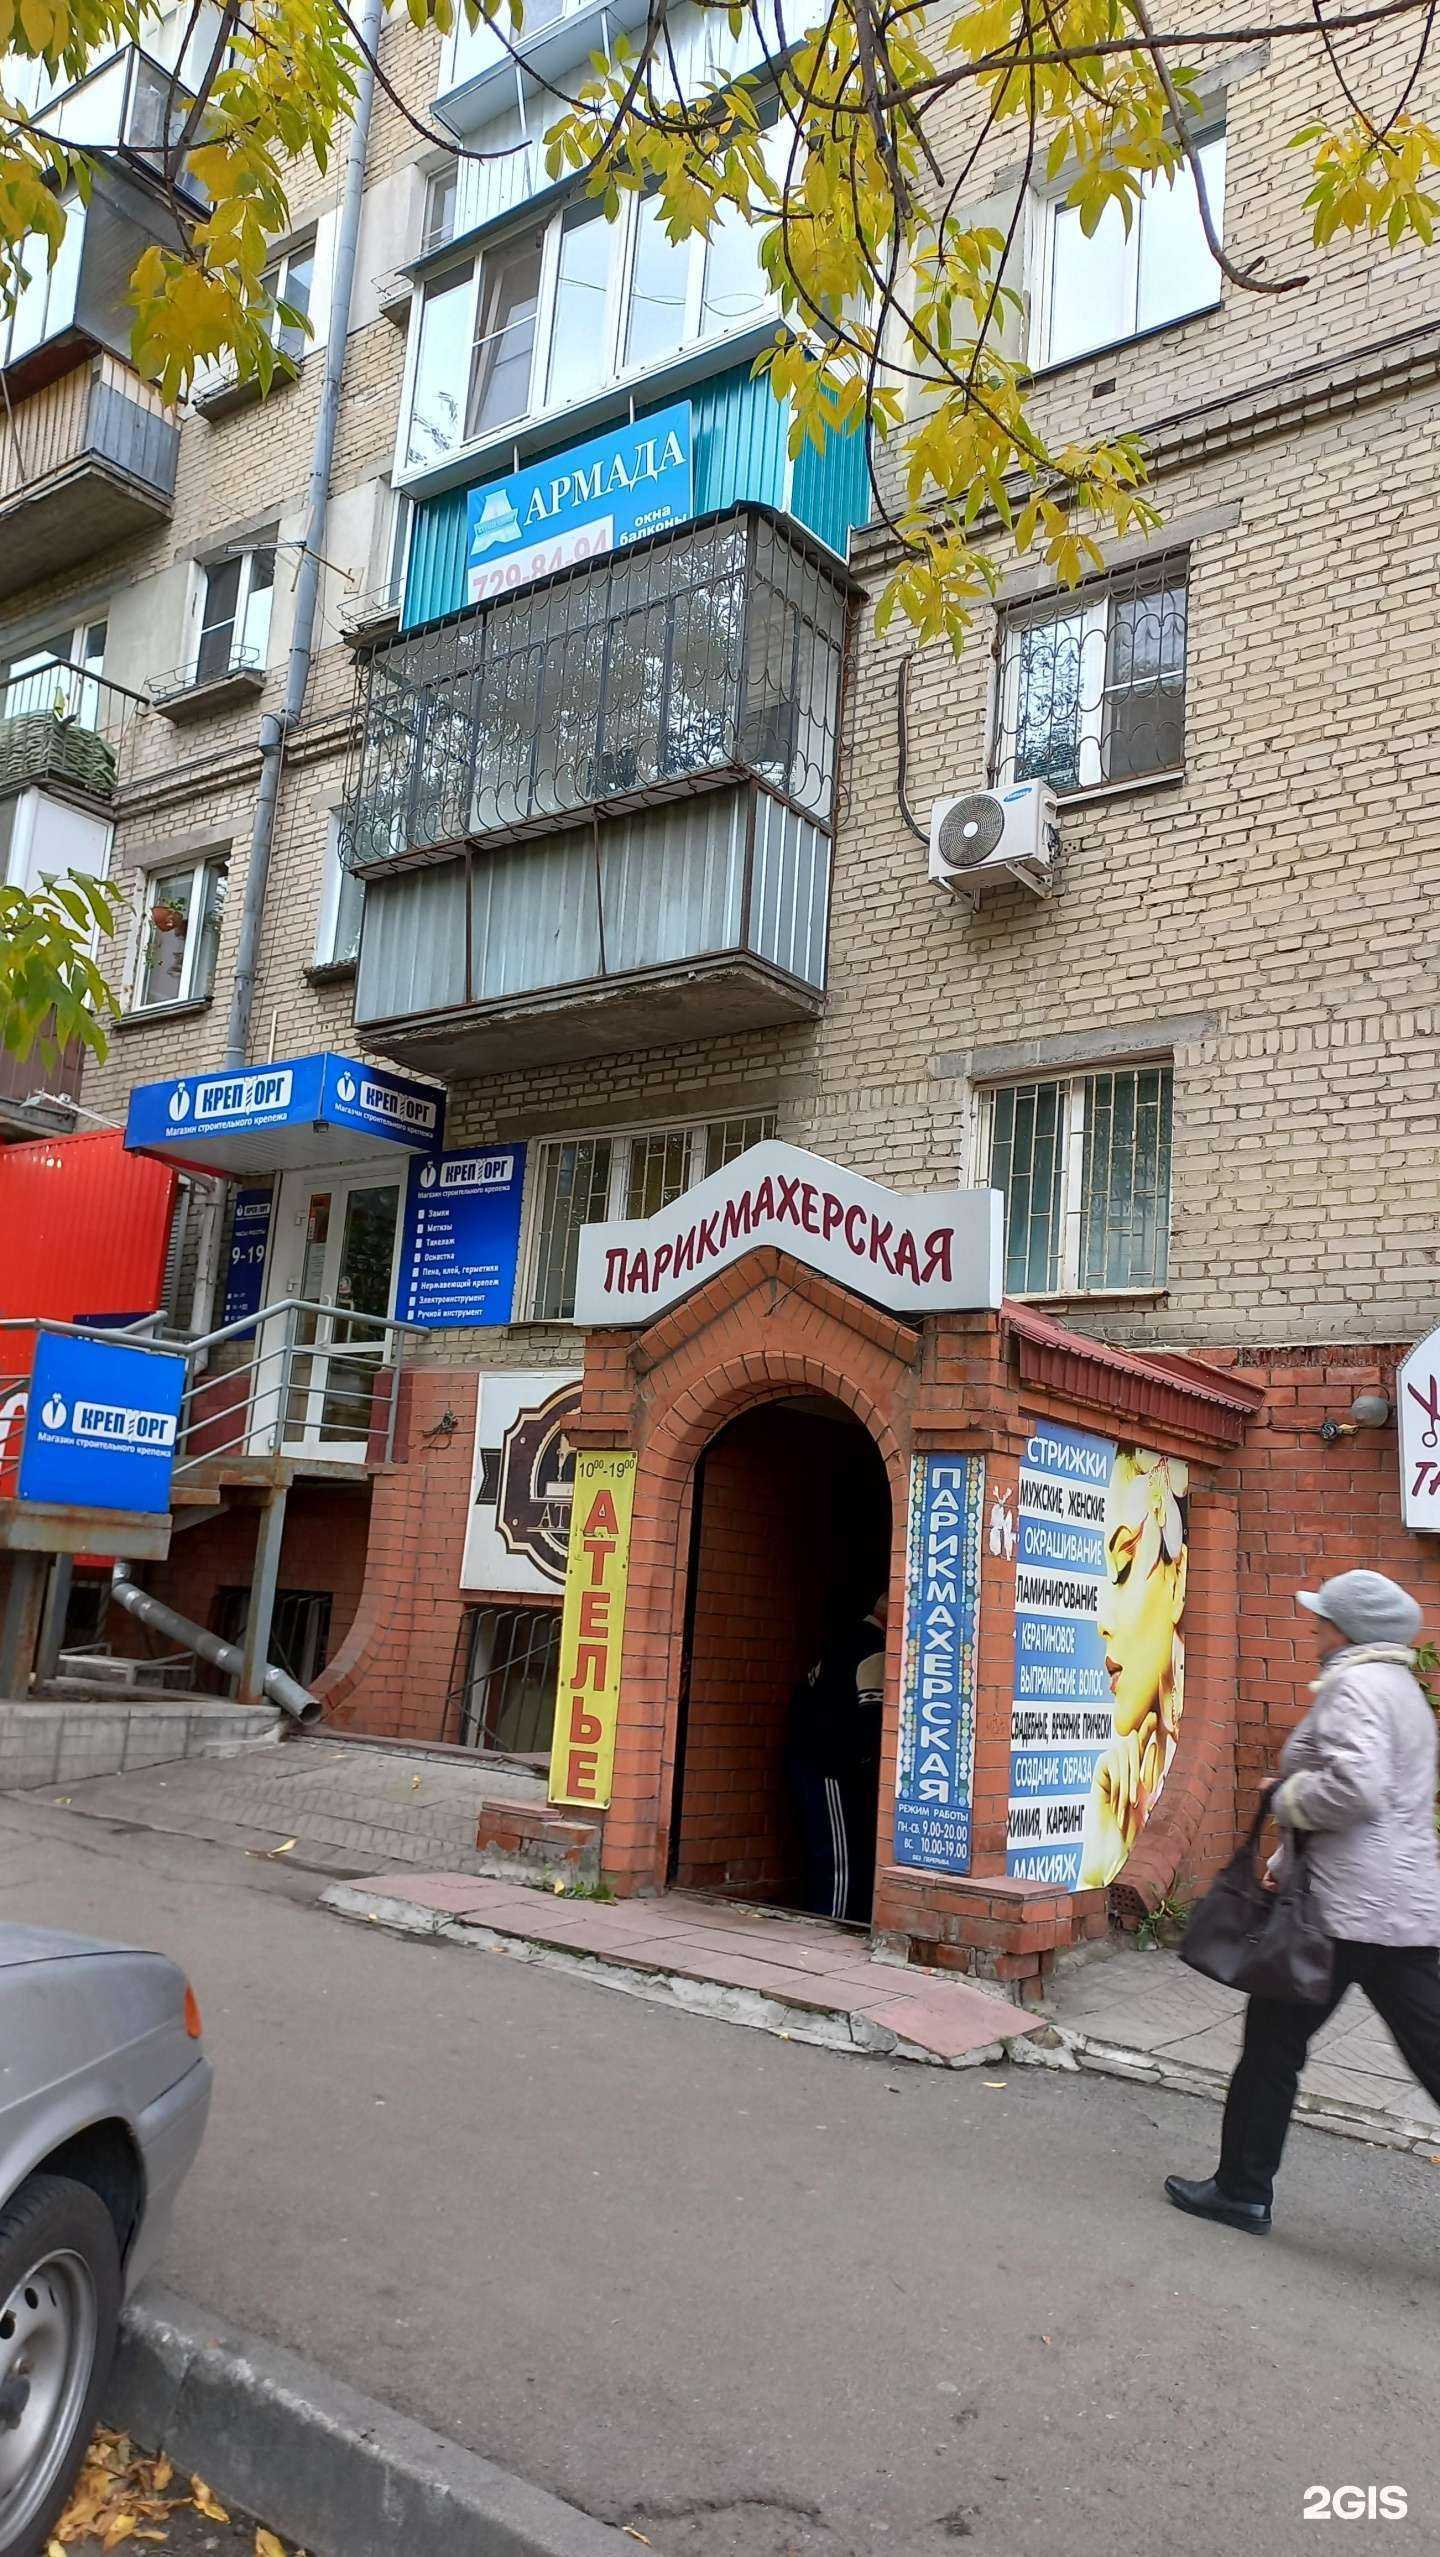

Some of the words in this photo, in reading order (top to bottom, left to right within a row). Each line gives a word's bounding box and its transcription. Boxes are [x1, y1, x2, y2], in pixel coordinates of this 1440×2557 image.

[524, 430, 687, 526] АРМАДА
[619, 513, 688, 546] балконы
[634, 505, 672, 528] окна
[165, 1126, 197, 1137] Магазин
[198, 1117, 252, 1134] строительного
[254, 1112, 288, 1125] крепежа
[335, 1102, 363, 1118] Магазин
[363, 1111, 406, 1131] строительного
[427, 1223, 453, 1232] Метизы
[428, 1209, 450, 1218] Замки
[603, 1174, 955, 1295] ПАРИКМАХЕРСКАЯ
[231, 1245, 265, 1264] 9-19
[424, 1253, 455, 1262] Оснастка
[417, 1309, 441, 1319] Ручной
[442, 1309, 483, 1318] инструмент
[37, 1431, 75, 1446] Магазин
[75, 1437, 136, 1453] строительного
[136, 1447, 172, 1458] крепежа
[1026, 1436, 1108, 1480] СТРИЖКИ
[1020, 1478, 1064, 1519] МУЖСКИЕ,
[1068, 1489, 1105, 1523] ЖЕНСКИЕ
[1024, 1526, 1103, 1566] ОКРАШИВАНИЕ
[1016, 1574, 1098, 1612] ЛАМИНИРОВАНИЕ
[566, 1489, 620, 1800] АТЕЛЬЕ
[917, 1467, 963, 1804] ПАРИКМАХЕРСКАЯ
[1021, 1621, 1076, 1655] КЕРАТИНОВОЕ
[1020, 1665, 1077, 1695] ВЫПРЯМЛЕНИЕ
[1078, 1670, 1104, 1696] ВОЛОС
[1011, 1712, 1050, 1748] СВАДЕБНЫЕ,
[1051, 1712, 1081, 1740] ВЕЧЕРНИЕ
[1083, 1713, 1112, 1740] ПРИЧЕСКИ
[1015, 1756, 1059, 1795] СОЗДАНИЕ
[1062, 1756, 1092, 1783] ОБРАЗА
[898, 1803, 930, 1817] РЕЖИМ
[933, 1808, 969, 1822] РАБОТЫ
[1007, 1807, 1042, 1840] ХИМИЯ,
[1046, 1804, 1085, 1836] КАРВИНГ
[922, 1820, 968, 1842] 9.00-20.00
[904, 1837, 914, 1849] ВС.
[921, 1837, 968, 1859] 10.00-19.00
[1013, 1852, 1077, 1882] МАКИЯЖ
